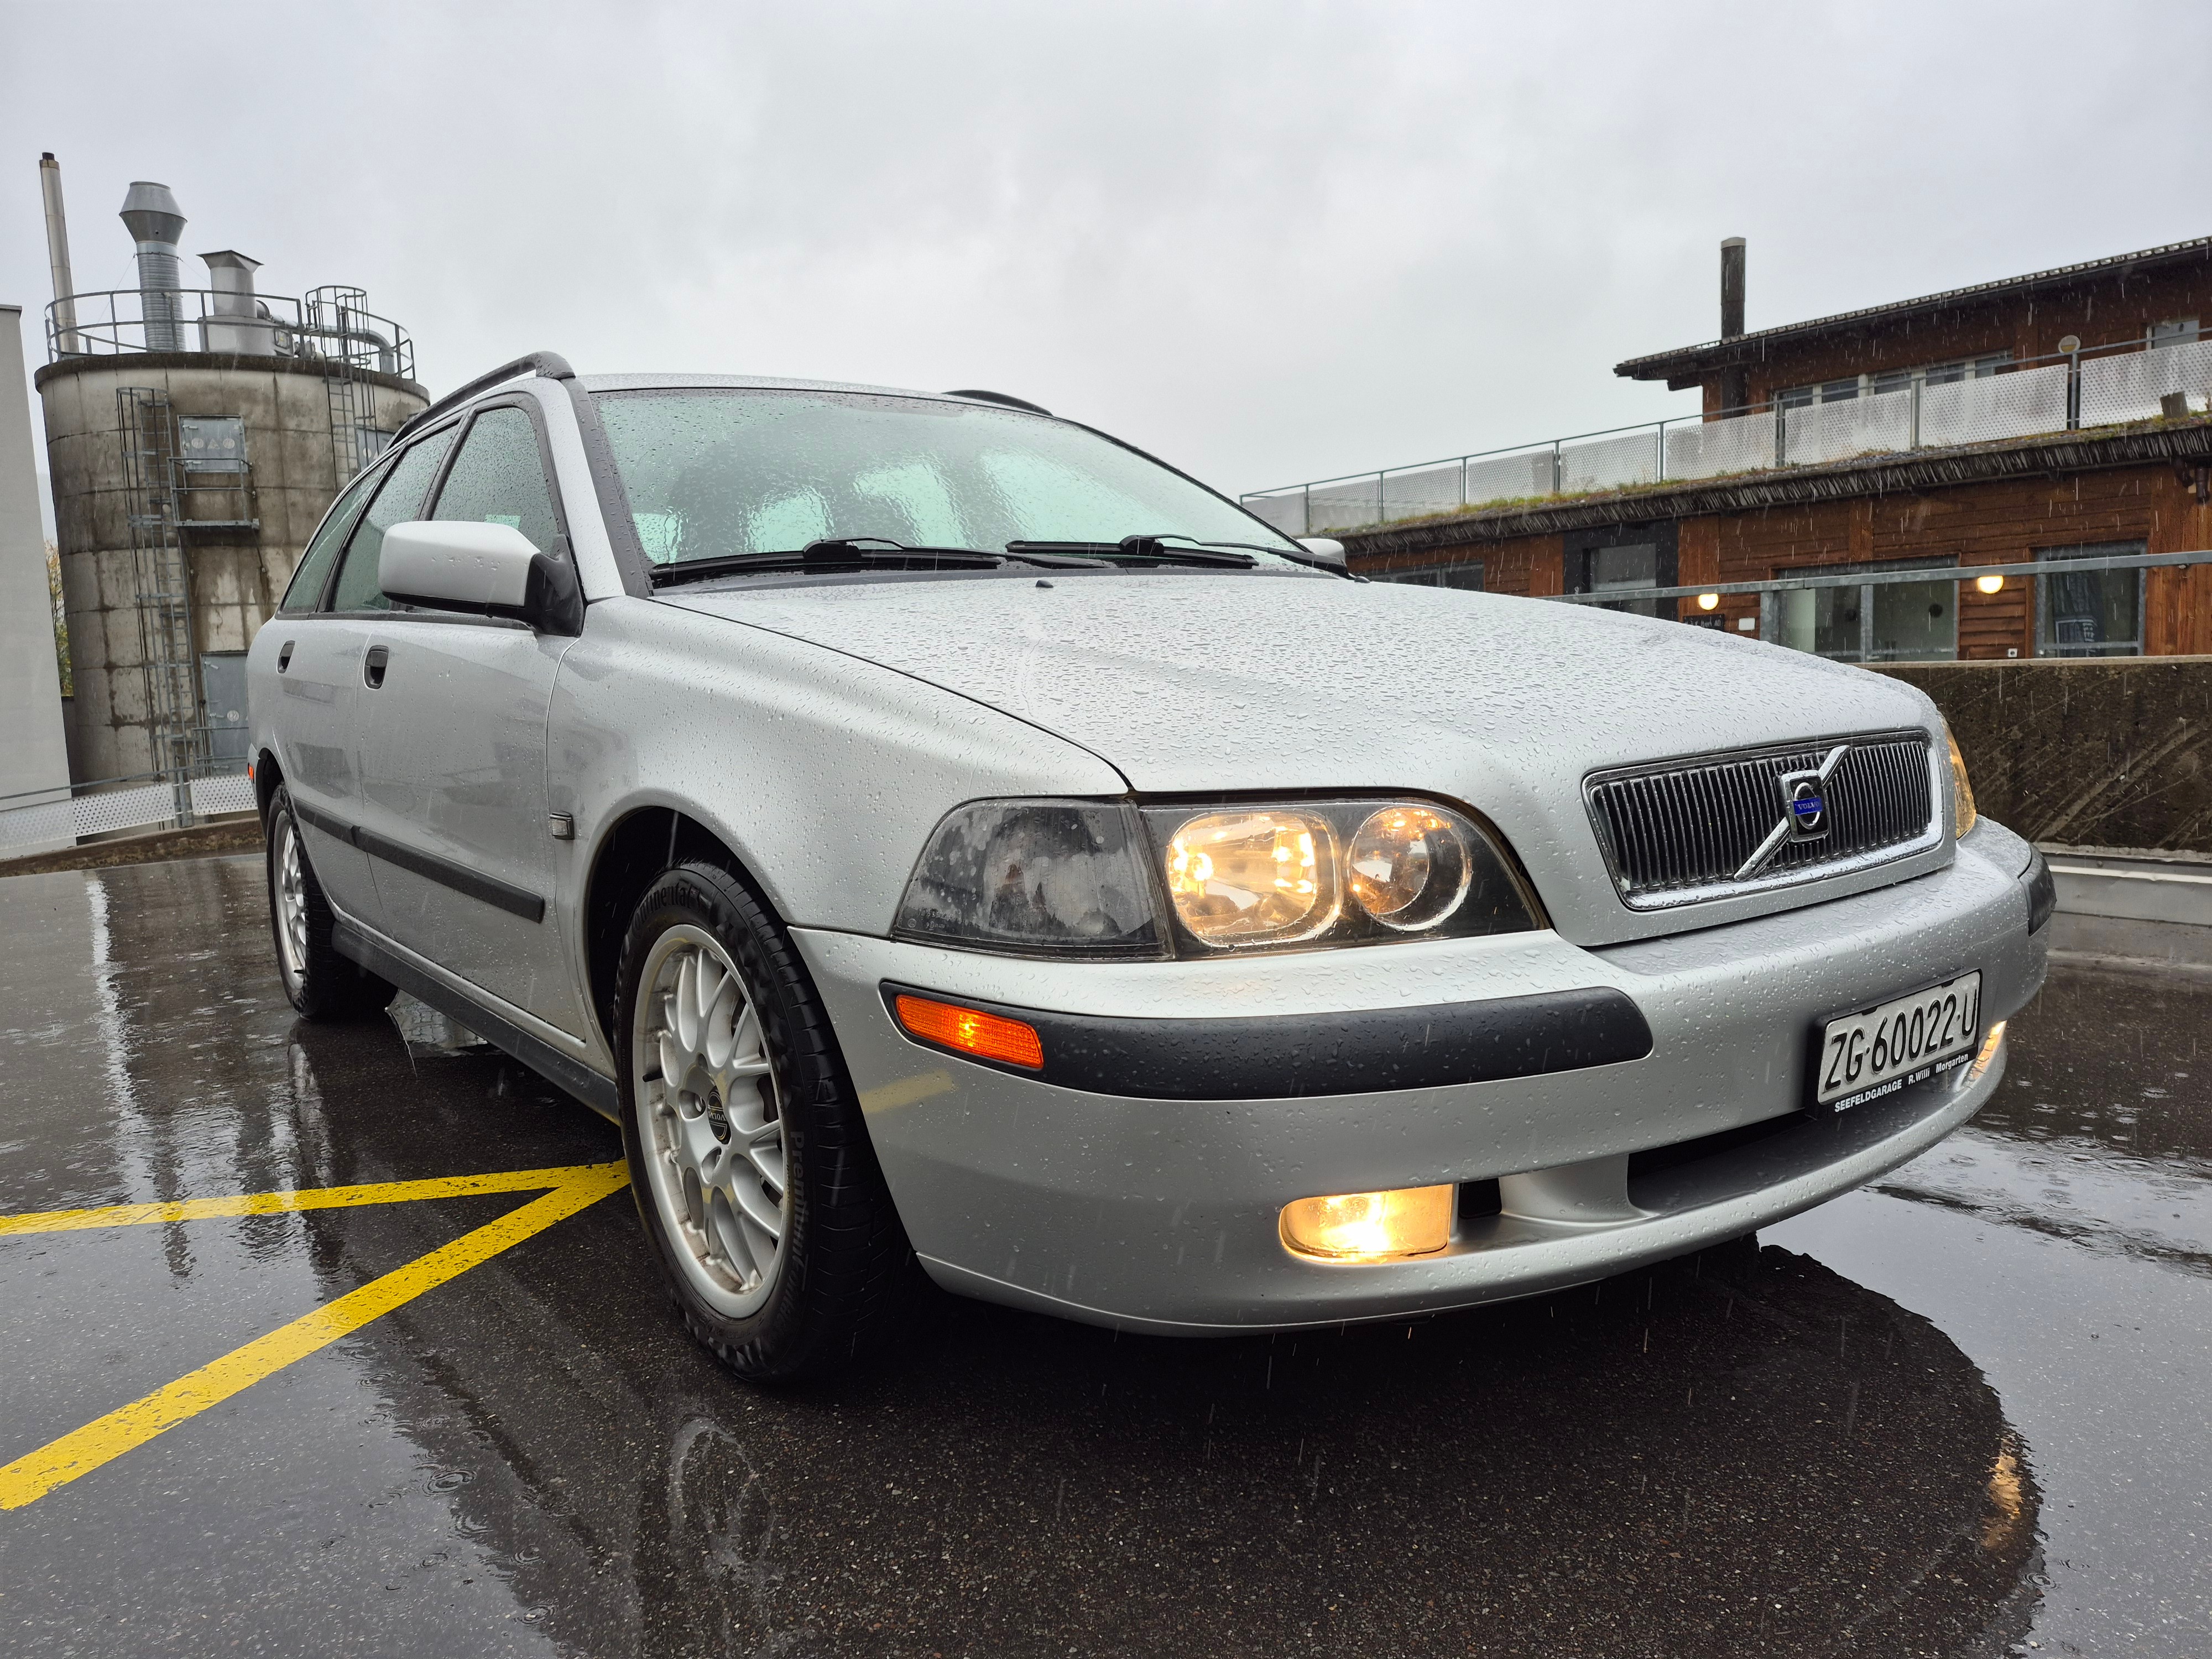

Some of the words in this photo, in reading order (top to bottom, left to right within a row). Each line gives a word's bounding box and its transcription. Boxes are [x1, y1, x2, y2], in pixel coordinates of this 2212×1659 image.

[1797, 801, 1820, 810] VOLVO
[1834, 1079, 1902, 1113] SEEFELDGARAGE
[1908, 1067, 1930, 1085] R.Willi
[1936, 1053, 1969, 1073] Morgarten
